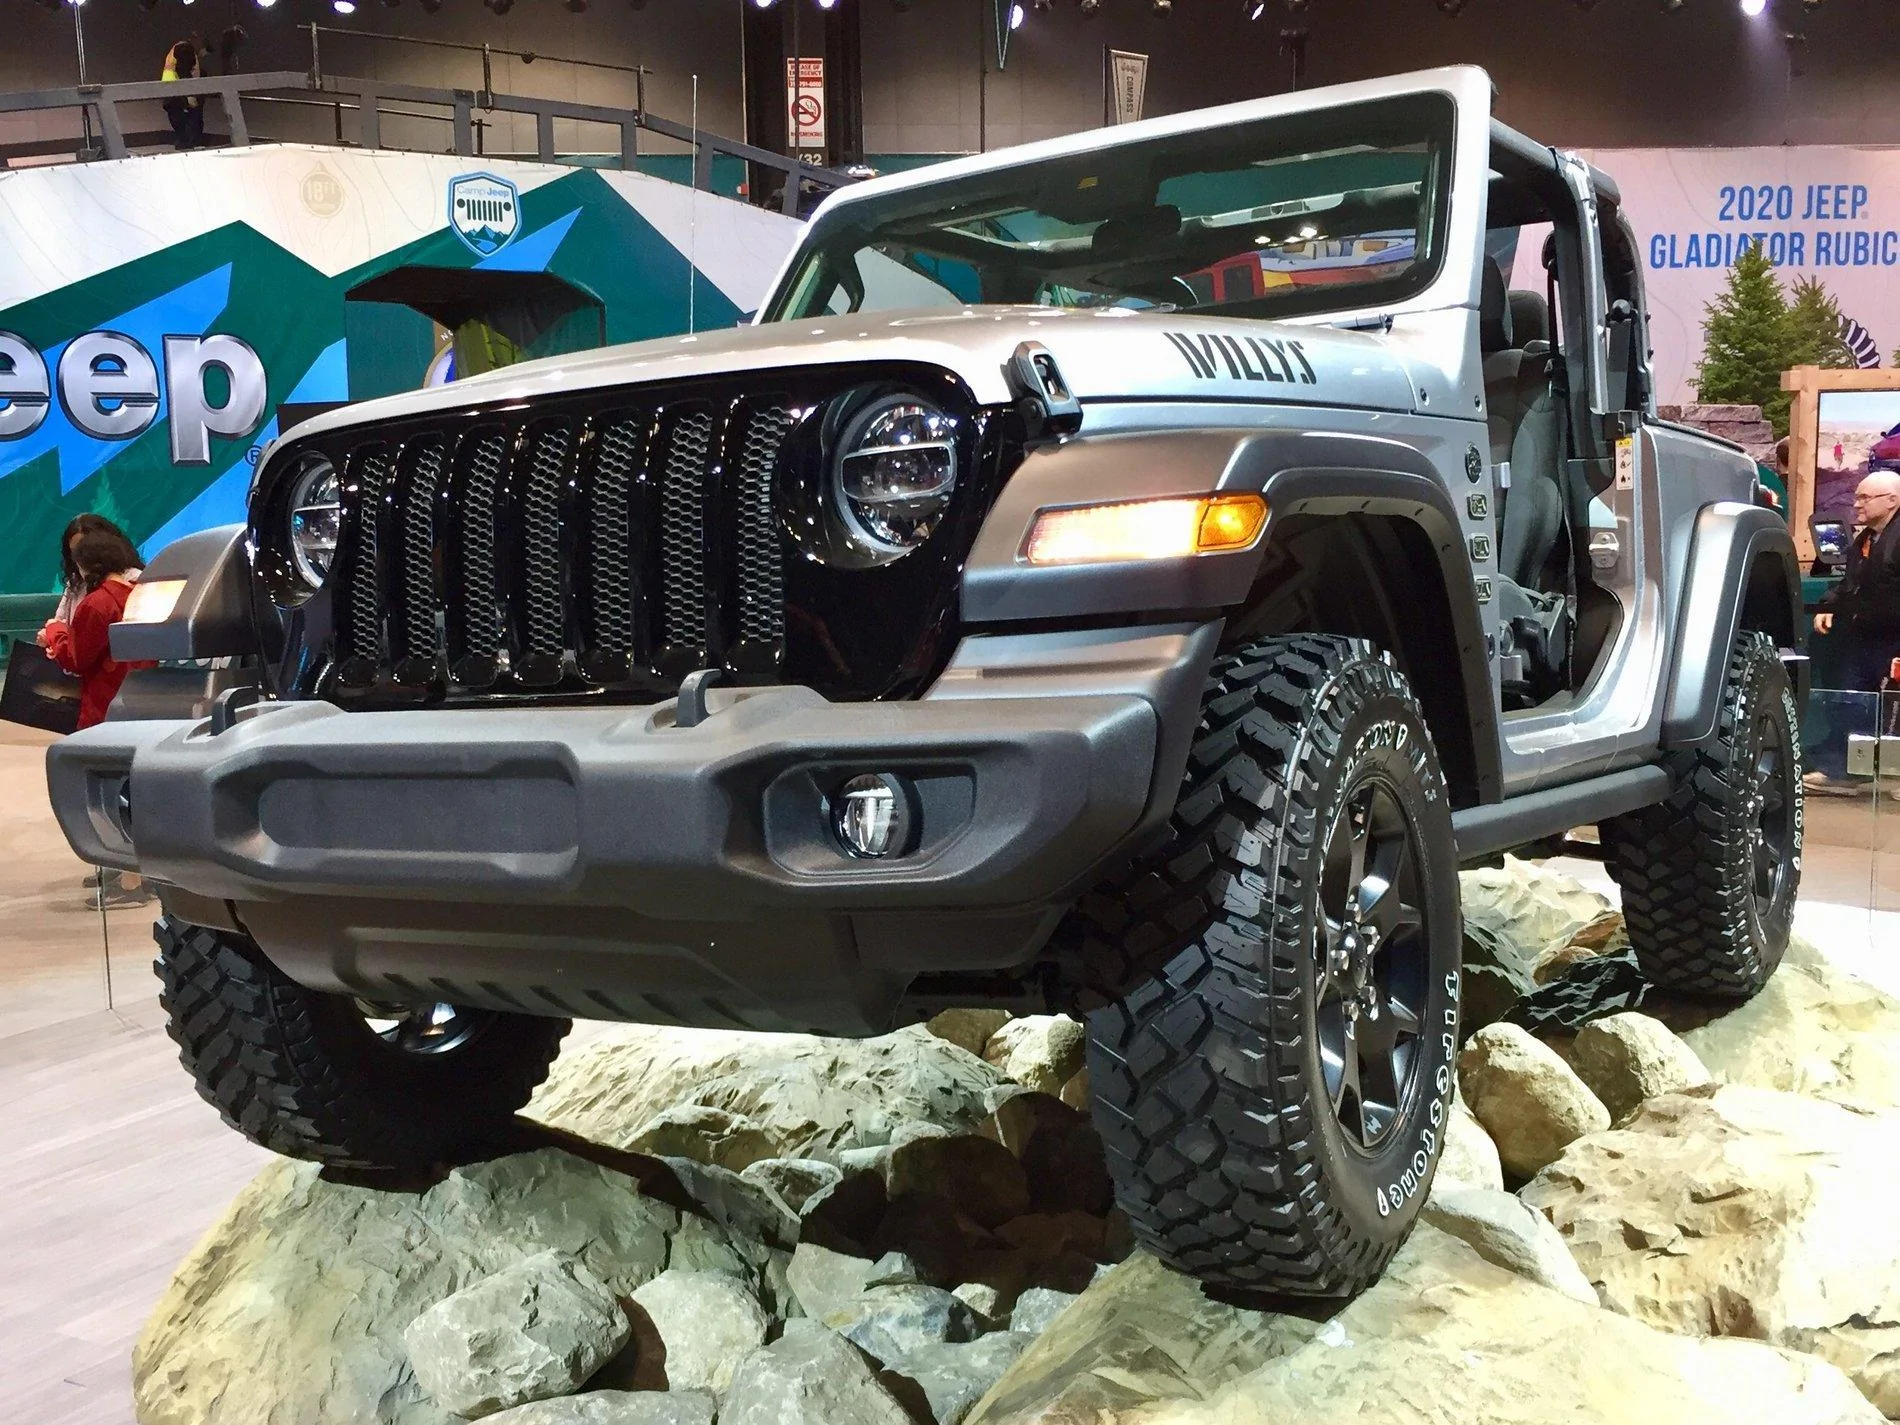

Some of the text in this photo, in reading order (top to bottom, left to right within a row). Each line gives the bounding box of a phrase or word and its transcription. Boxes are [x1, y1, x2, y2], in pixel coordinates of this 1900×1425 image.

[1126, 76, 1135, 114] COMPASS
[457, 185, 510, 199] Camp Jeep
[1719, 184, 1868, 221] 2020 JEEP
[1650, 232, 1806, 269] GLADIATOR
[1163, 332, 1317, 385] WILLYS
